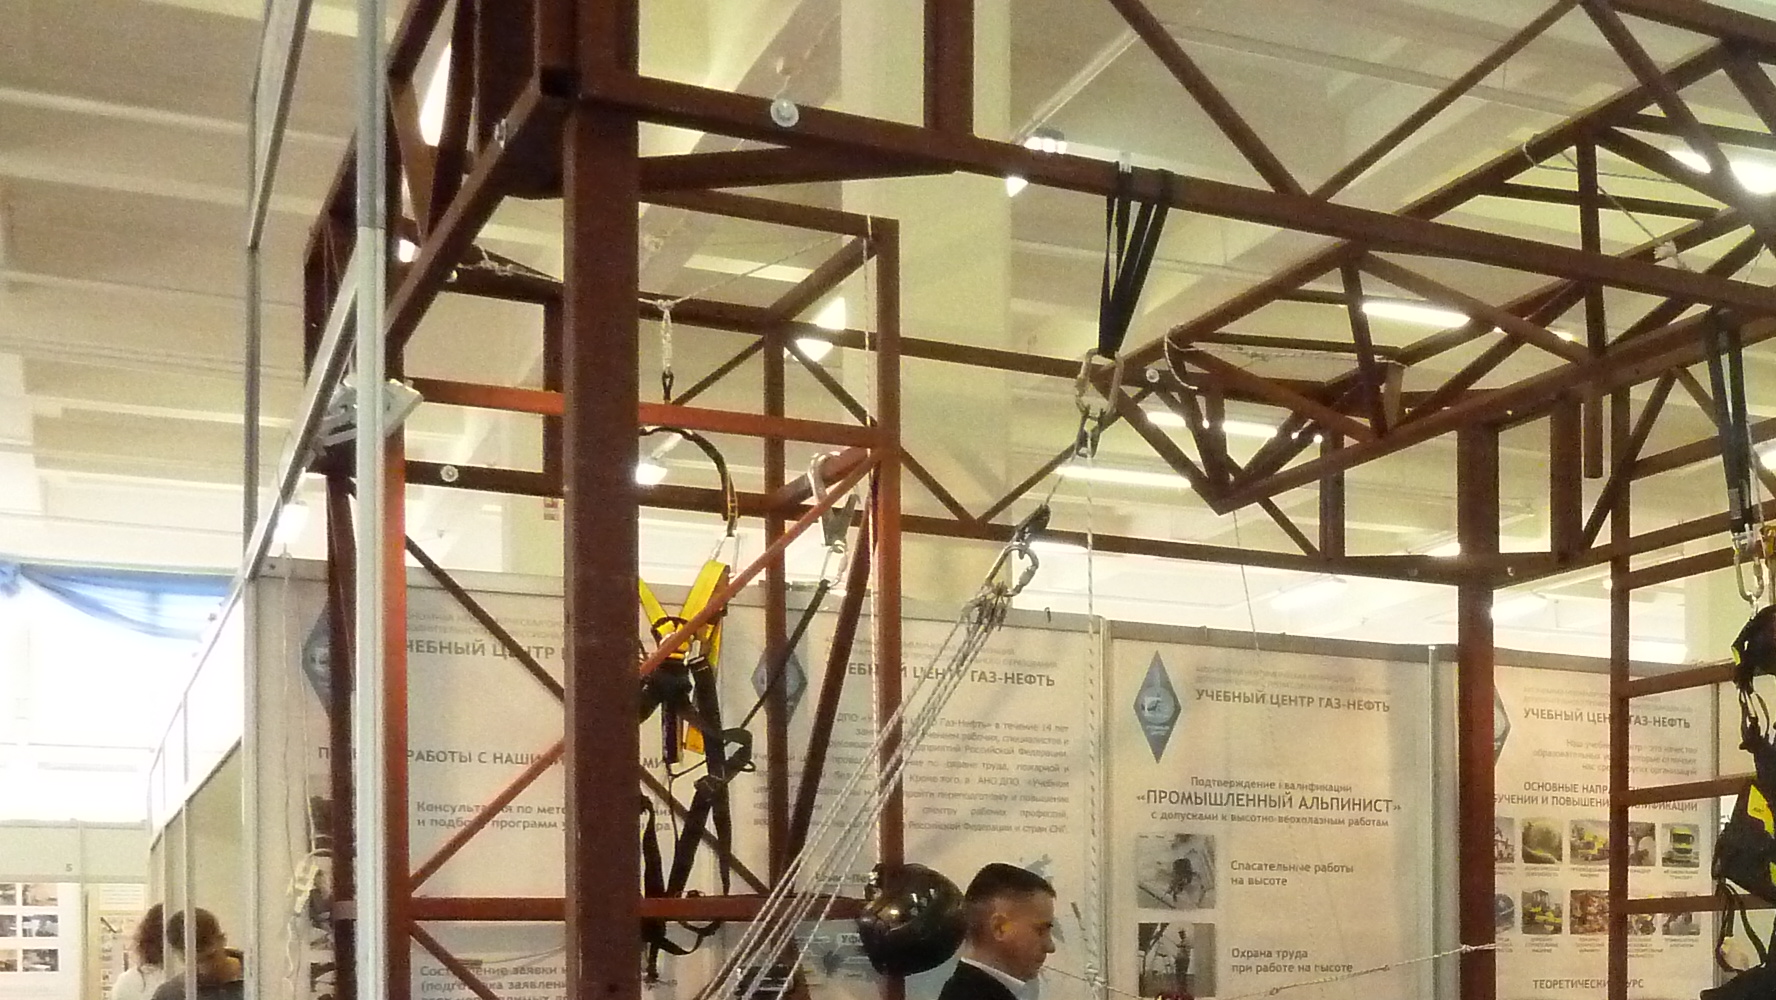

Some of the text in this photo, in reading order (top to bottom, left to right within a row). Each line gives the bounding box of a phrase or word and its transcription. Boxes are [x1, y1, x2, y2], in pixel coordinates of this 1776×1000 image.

[970, 670, 1055, 687] ГАЗ-НЕФТЬ
[1195, 688, 1391, 713] УЧЕБНЫЙ ЦЕНТР ГАЗ-НЕФТЬ
[1523, 708, 1584, 723] УЧЕБНЫЙ
[1190, 776, 1277, 791] Подтверждение
[1523, 780, 1579, 794] ОСНОВНЫЕ
[1136, 789, 1402, 814] «ПРОМЫШЛЕННЫЙ АЛЬПИНИСТ»
[1314, 862, 1355, 875] работы
[1230, 876, 1288, 887] на высоте
[1231, 948, 1309, 961] Охрана труда
[1532, 977, 1610, 990] ТЕОРЕТИЧЕСКИ
